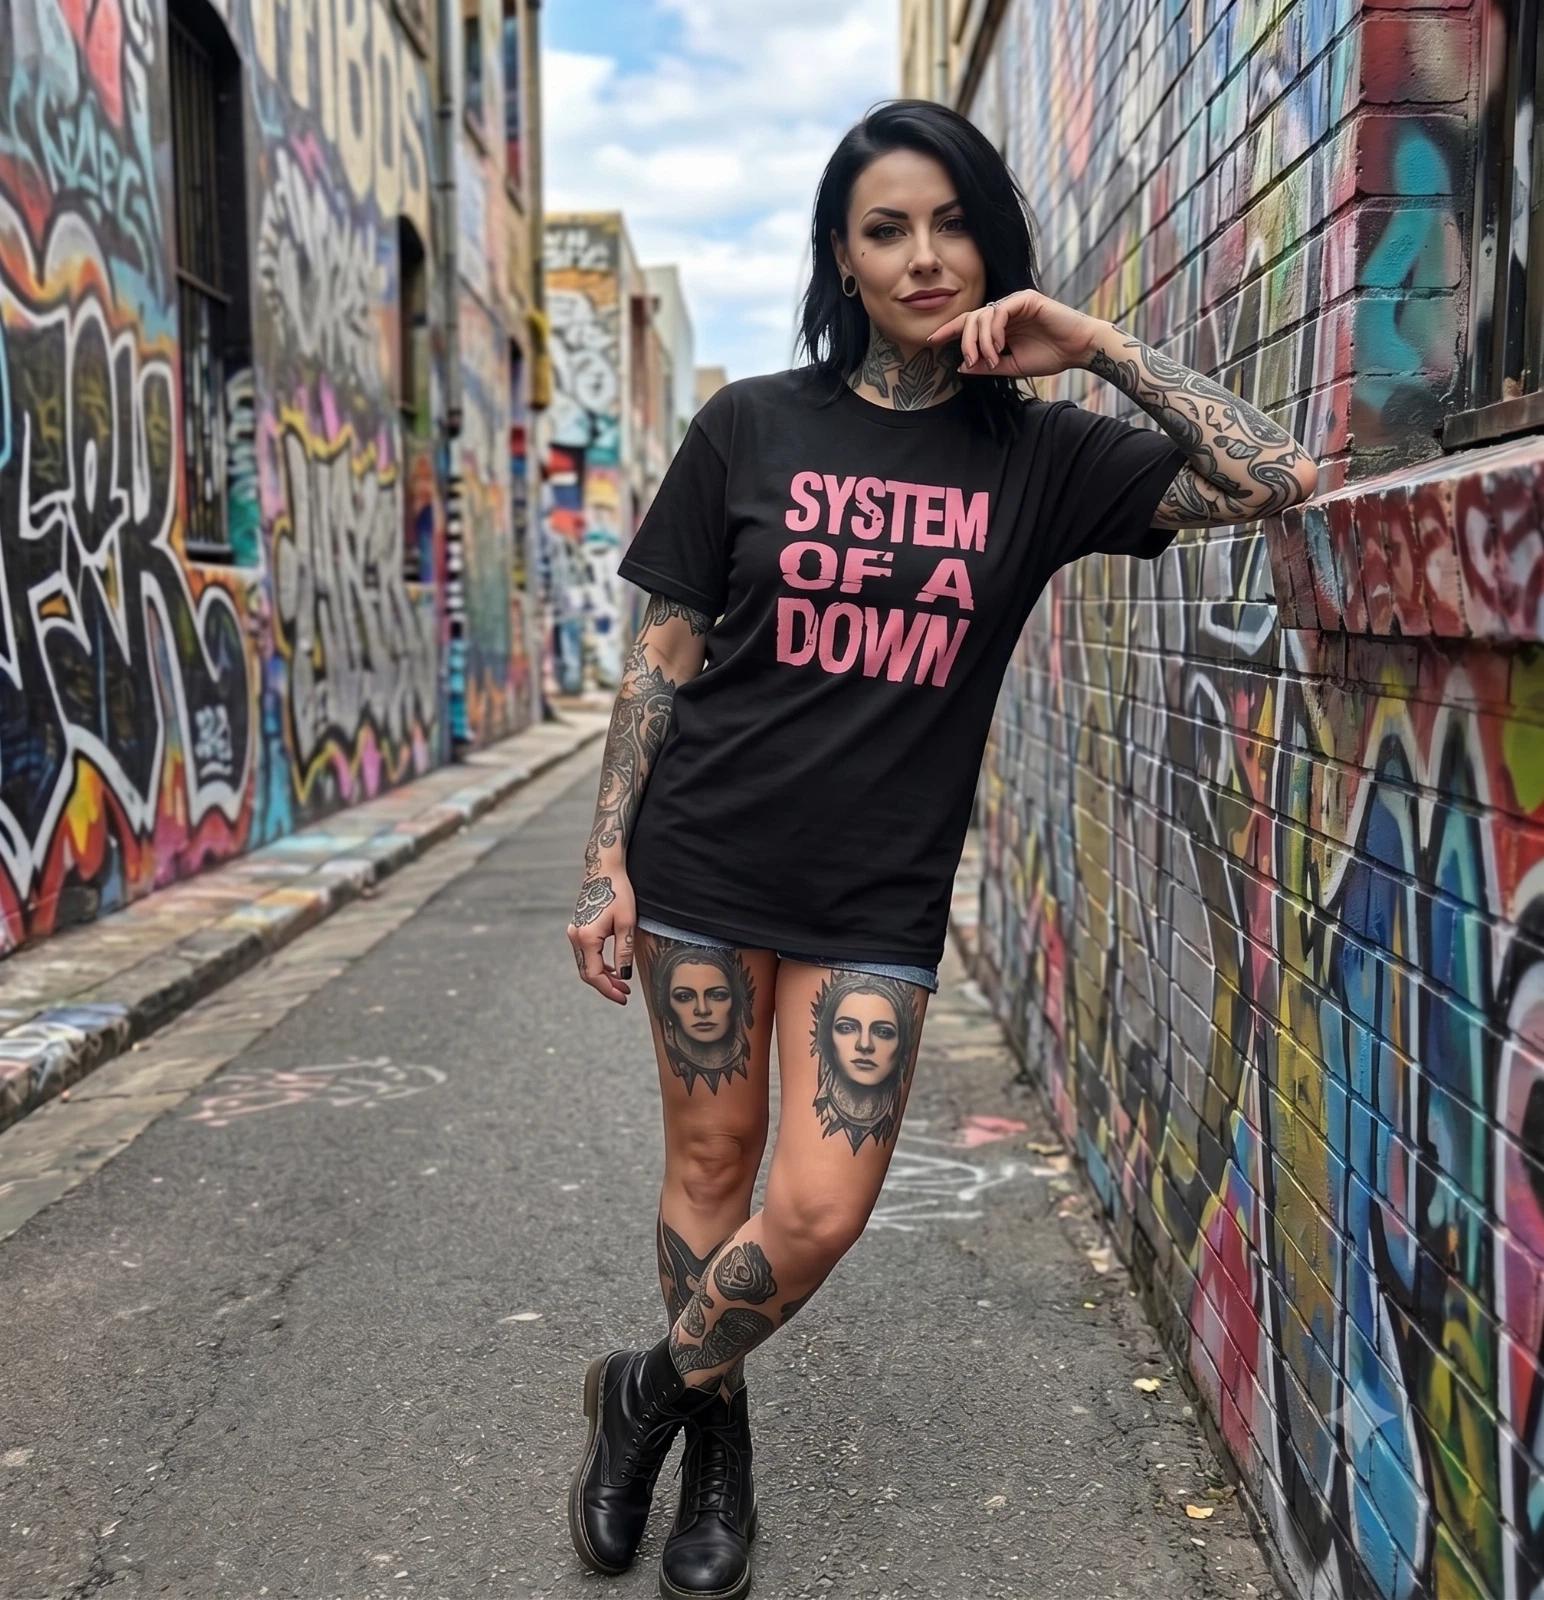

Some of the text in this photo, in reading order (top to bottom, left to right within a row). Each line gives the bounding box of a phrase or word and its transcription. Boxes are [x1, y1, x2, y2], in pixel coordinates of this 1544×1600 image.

[785, 471, 989, 552] SYSTEM
[779, 541, 974, 611] OF A
[777, 597, 970, 687] DOWN
